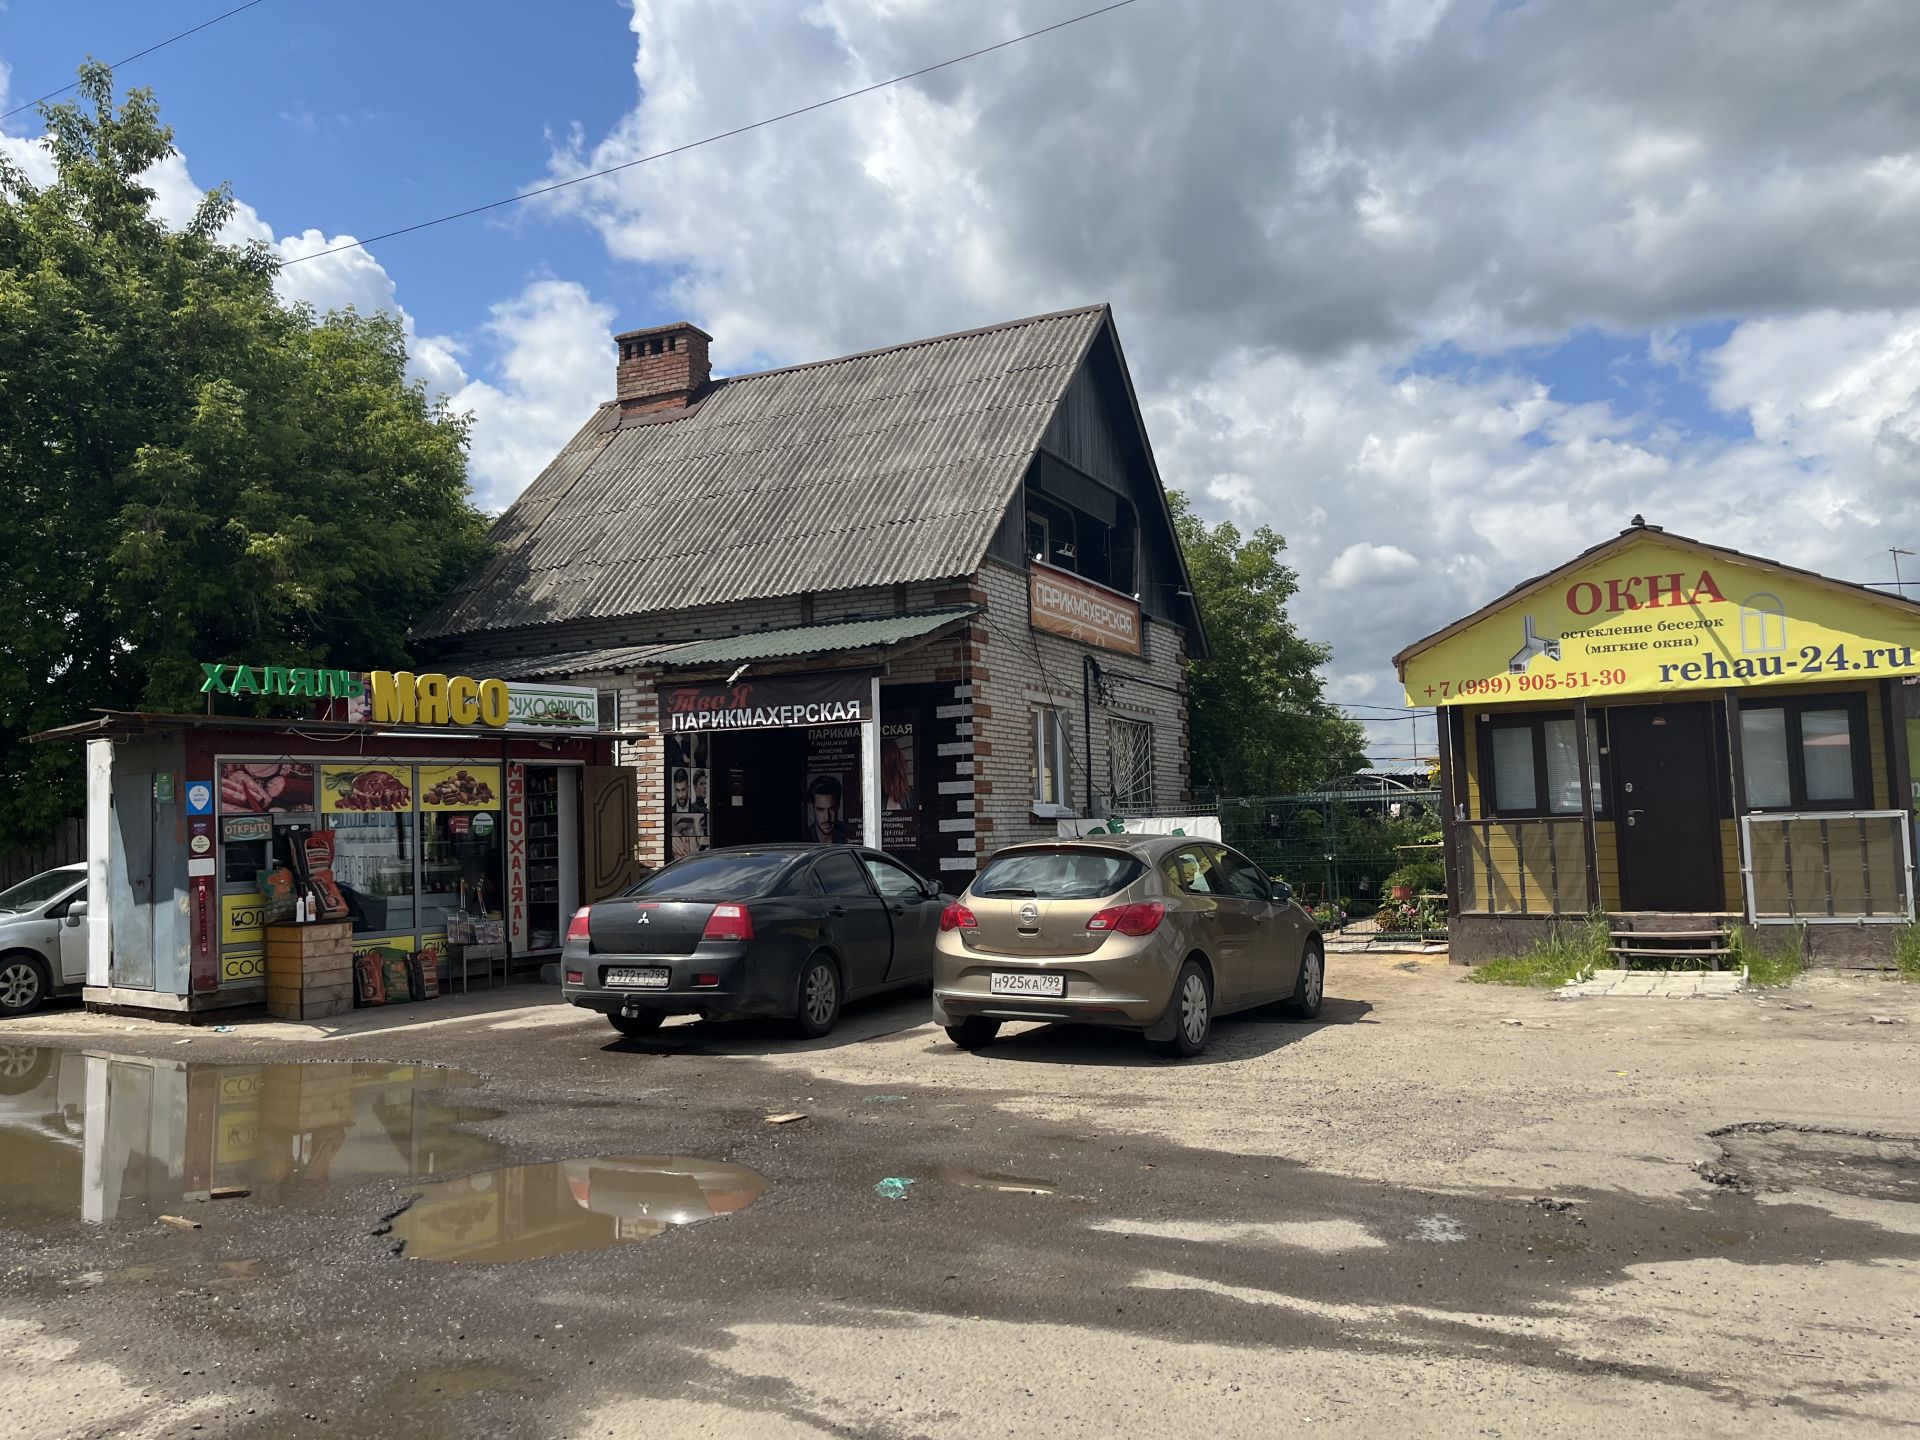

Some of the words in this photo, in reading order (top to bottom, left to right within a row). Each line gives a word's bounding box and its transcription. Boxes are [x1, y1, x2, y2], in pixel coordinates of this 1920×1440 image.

[1036, 582, 1133, 635] ПАРИКМАХЕРСКАЯ
[1565, 569, 1727, 617] ОКНА
[1560, 621, 1653, 641] остекление
[1656, 617, 1724, 633] беседок
[1585, 640, 1650, 656] (мягкие
[1653, 635, 1699, 652] окна)
[1659, 644, 1914, 683] rehau-24.ru
[200, 662, 365, 698] ХАЛЯЛЬ
[1423, 680, 1451, 699] +7
[1457, 677, 1512, 698] (999)
[1518, 668, 1627, 693] 905-51-30
[370, 670, 510, 728] МЯСО
[671, 700, 861, 732] ПАРИКМАХЕРСКАЯ
[224, 823, 270, 835] ОТКРЫТО
[231, 910, 265, 926] КОЛ
[226, 958, 265, 976] СОС
[994, 976, 1039, 990] Н925КА
[1041, 976, 1060, 987] 799
